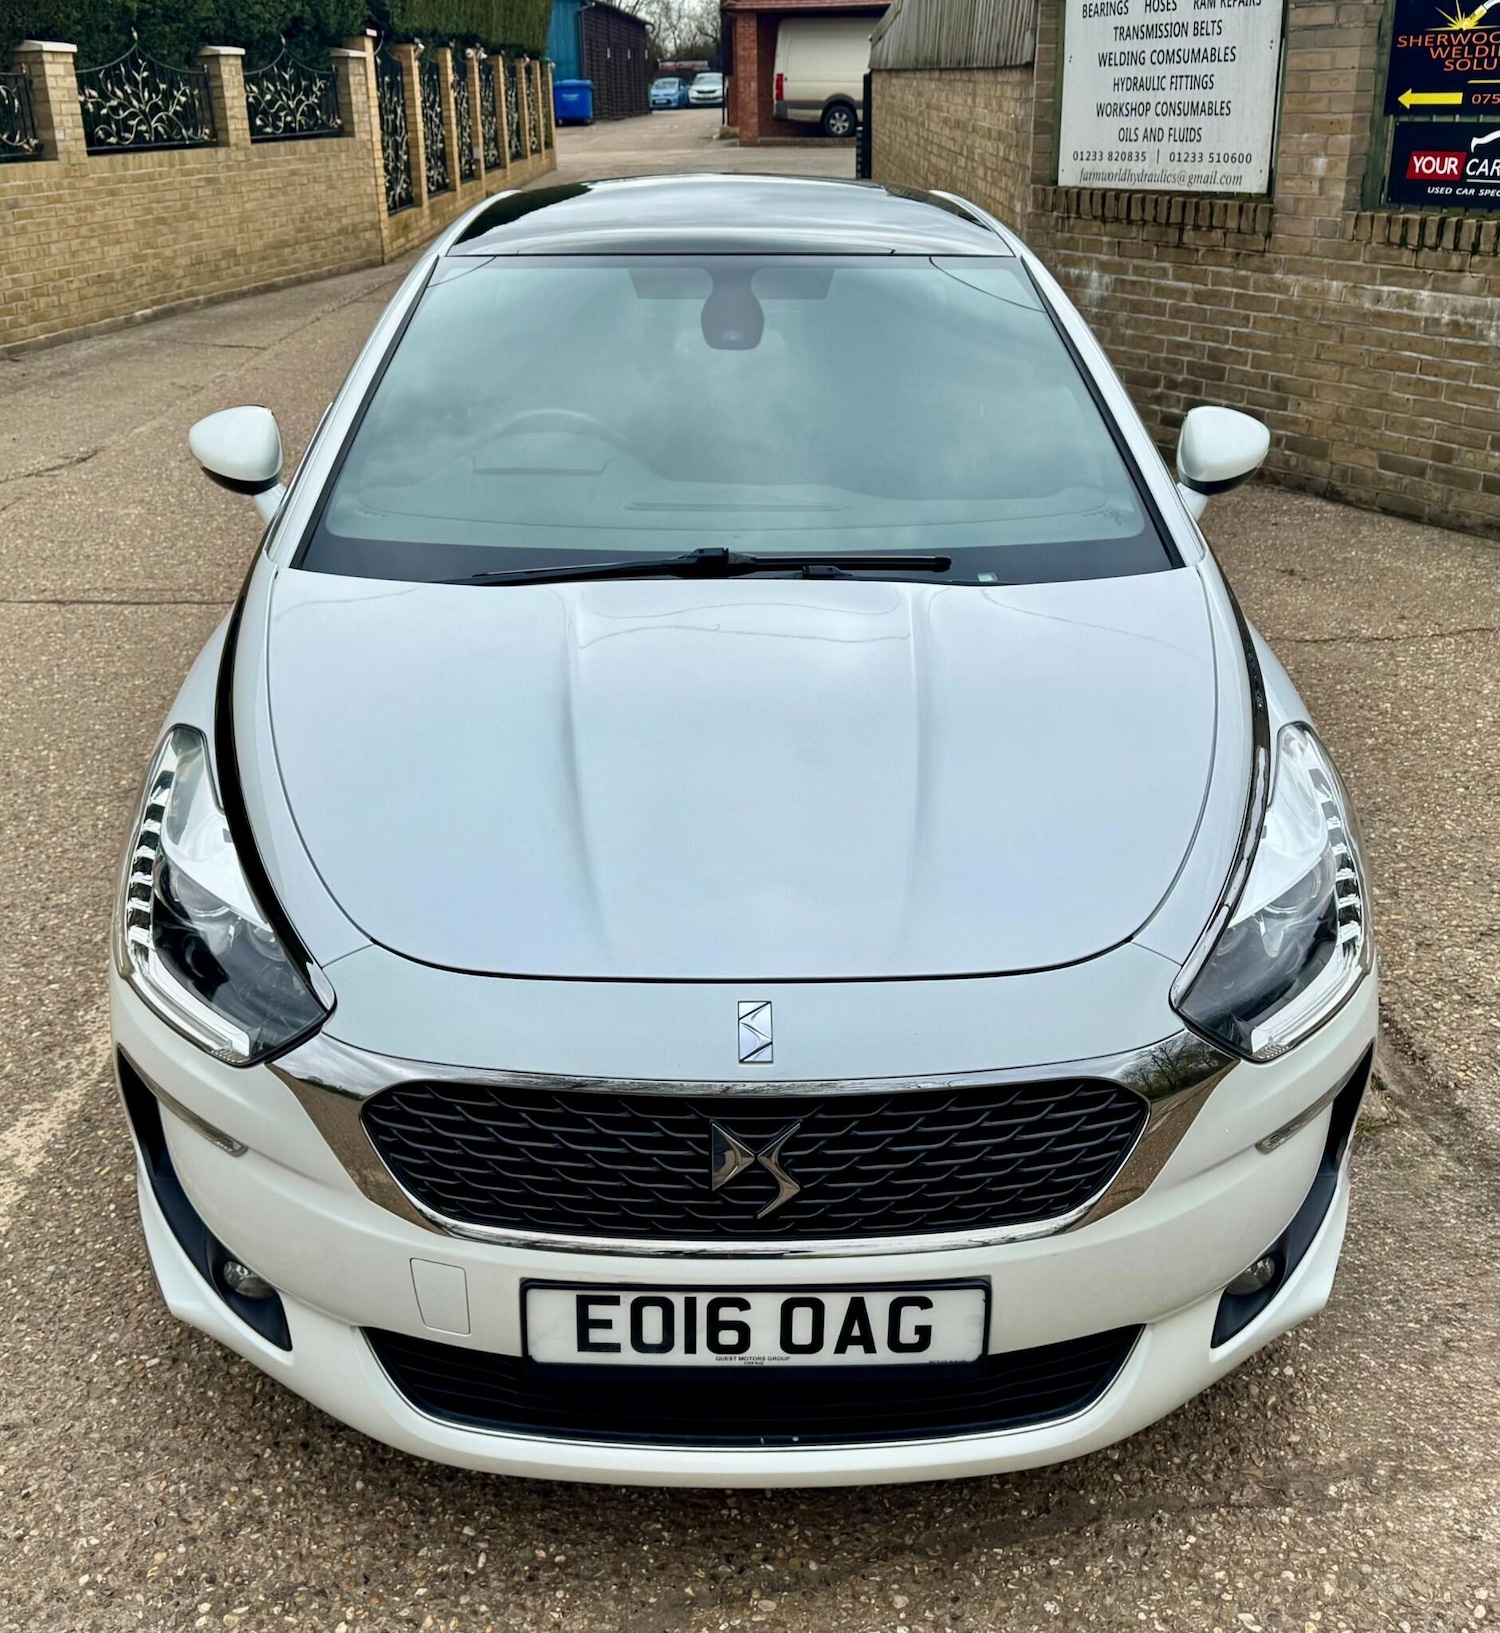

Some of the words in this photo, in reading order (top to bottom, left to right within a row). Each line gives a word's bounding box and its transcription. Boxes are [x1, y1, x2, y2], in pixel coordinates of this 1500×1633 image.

[1082, 0, 1129, 19] BEARINGS
[1145, 0, 1178, 13] HOSES
[1193, 0, 1216, 10] RAM
[1113, 21, 1188, 42] TRANSMISSION
[1193, 19, 1223, 37] BELTS
[1098, 50, 1146, 67] WELDING
[1150, 46, 1236, 65] COMSUMABLES
[1429, 45, 1500, 59] WELDI
[1113, 75, 1166, 92] HYDRAULIC
[1169, 74, 1215, 91] FITTINGS
[1471, 93, 1500, 105] 075
[1096, 101, 1151, 118] WORKSHOP
[1155, 100, 1232, 117] CONSUMABLES
[1118, 127, 1139, 143] OILS
[1142, 127, 1164, 143] AND
[1168, 127, 1202, 143] FLUIDS
[1072, 150, 1104, 162] 01233
[1107, 150, 1147, 162] 820835
[1169, 151, 1204, 164] 01233
[1208, 152, 1252, 164] 510600
[1412, 156, 1459, 175] YOUR
[1466, 158, 1500, 176] CAR
[1079, 167, 1243, 188] farmworldhydraulics@gmail.com
[1427, 186, 1453, 195] USED
[1455, 188, 1476, 196] CAR
[576, 1294, 752, 1355] EO16
[779, 1296, 934, 1355] OAG
